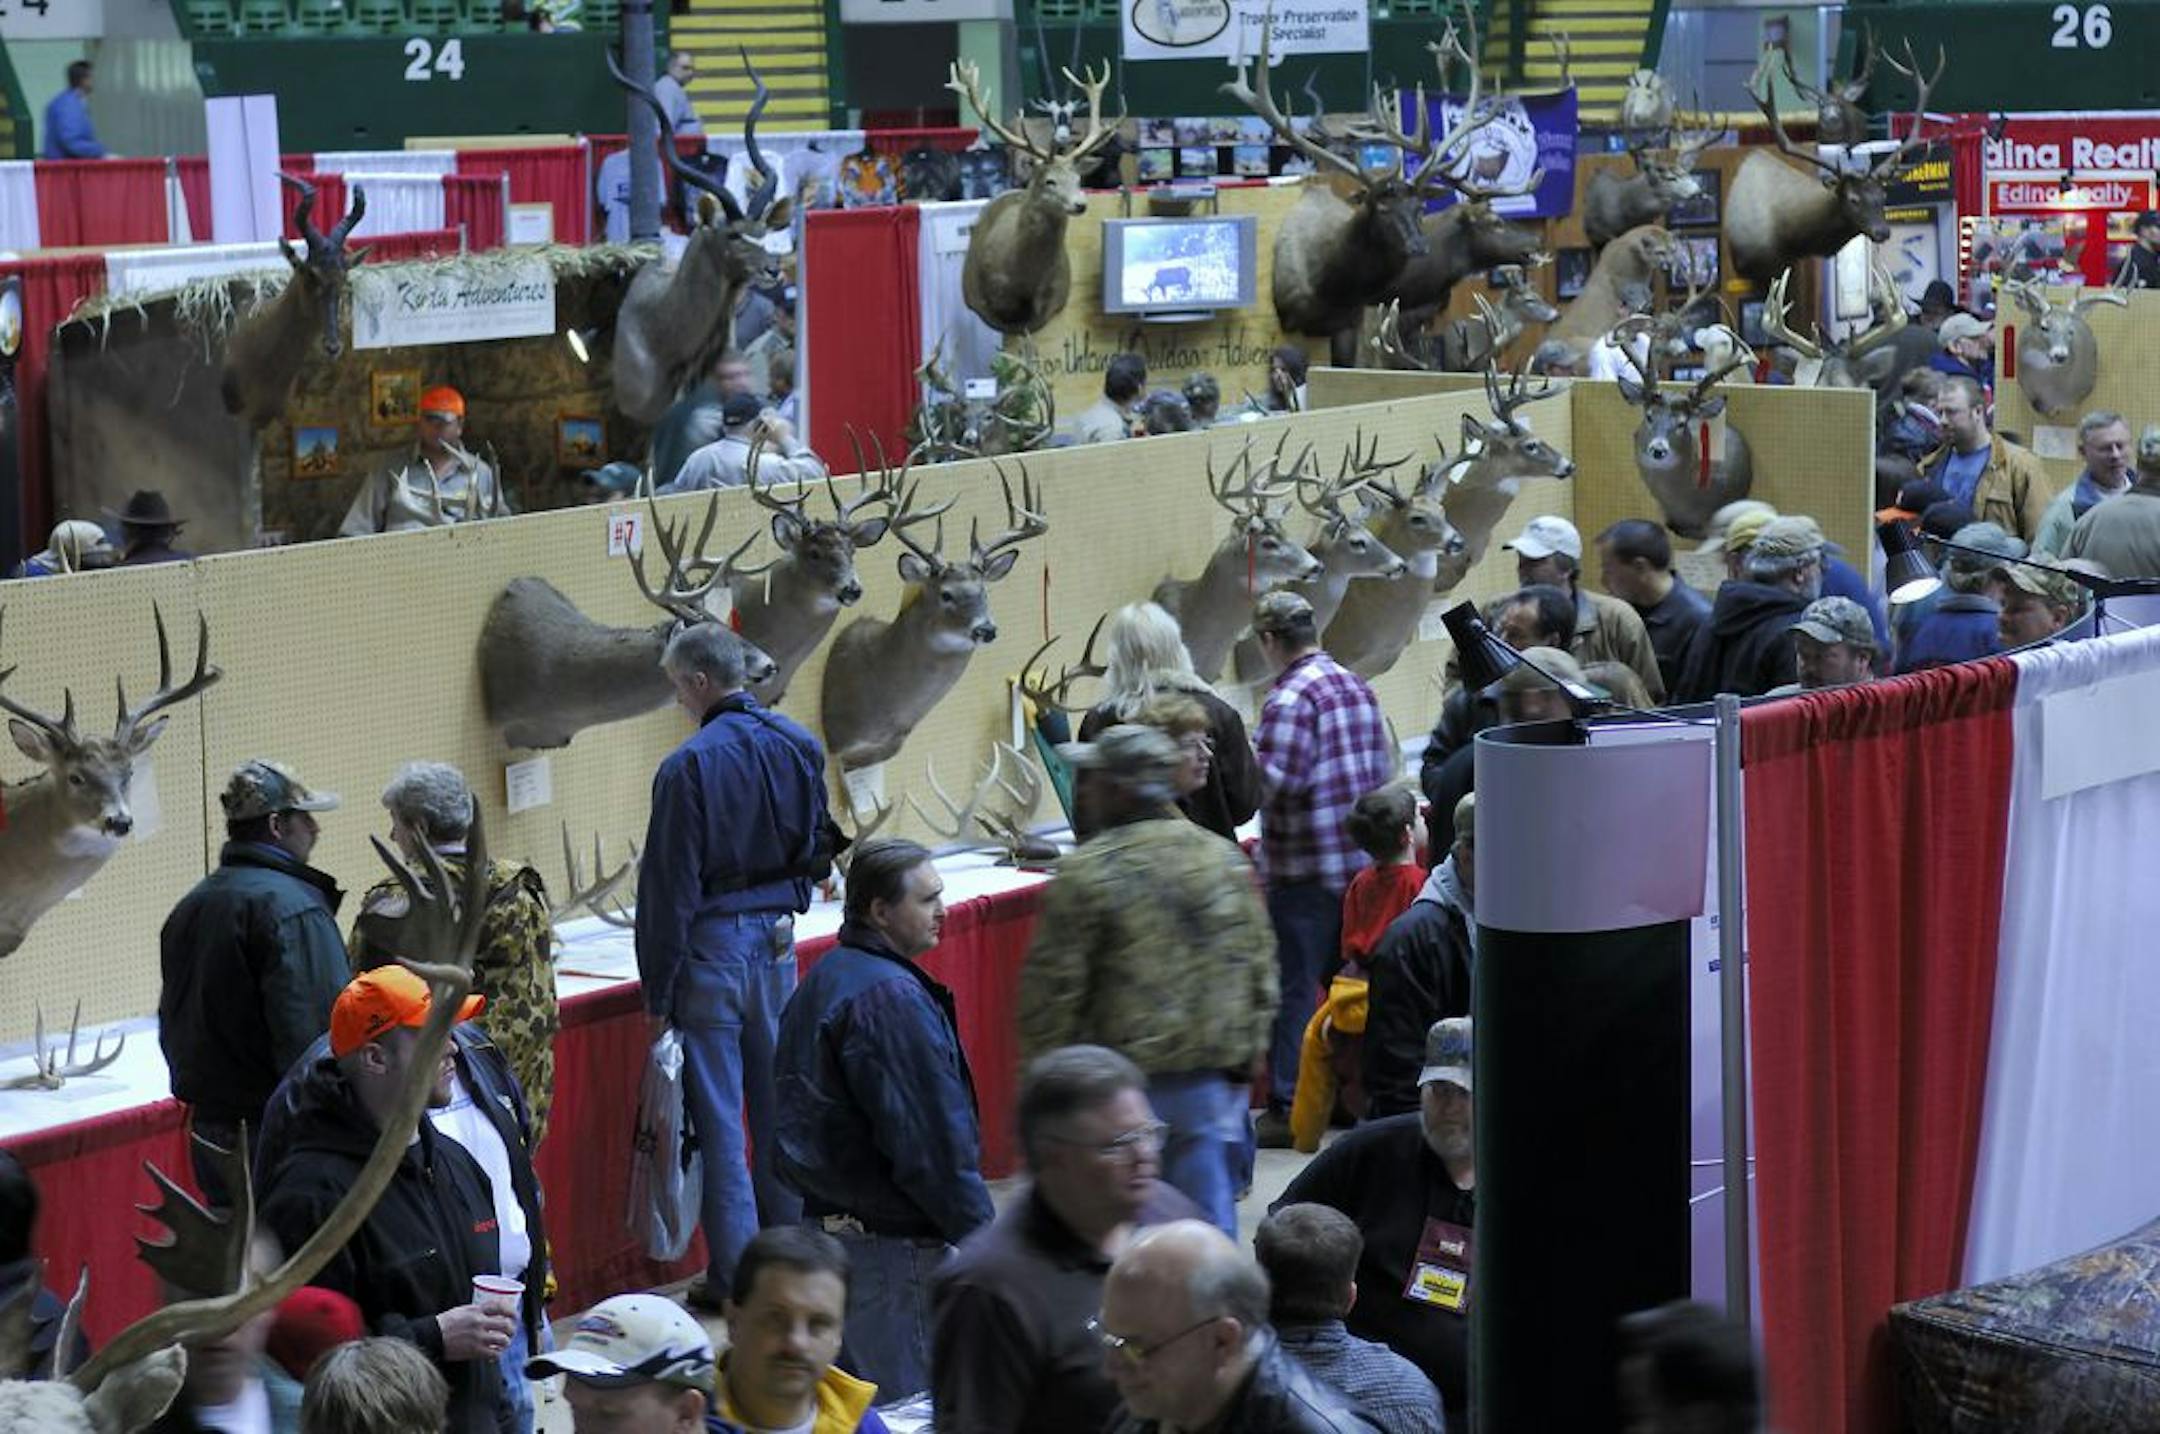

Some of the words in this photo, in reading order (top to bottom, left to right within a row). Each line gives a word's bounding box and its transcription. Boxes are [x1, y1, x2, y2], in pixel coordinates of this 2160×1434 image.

[1284, 9, 1359, 24] Preservation
[2051, 4, 2113, 48] 26
[1271, 26, 1326, 40] Specialist
[403, 37, 466, 81] 24
[1986, 137, 2061, 169] dina
[2072, 136, 2160, 169] Realt
[1998, 182, 2061, 203] Edina
[614, 520, 636, 546] #7
